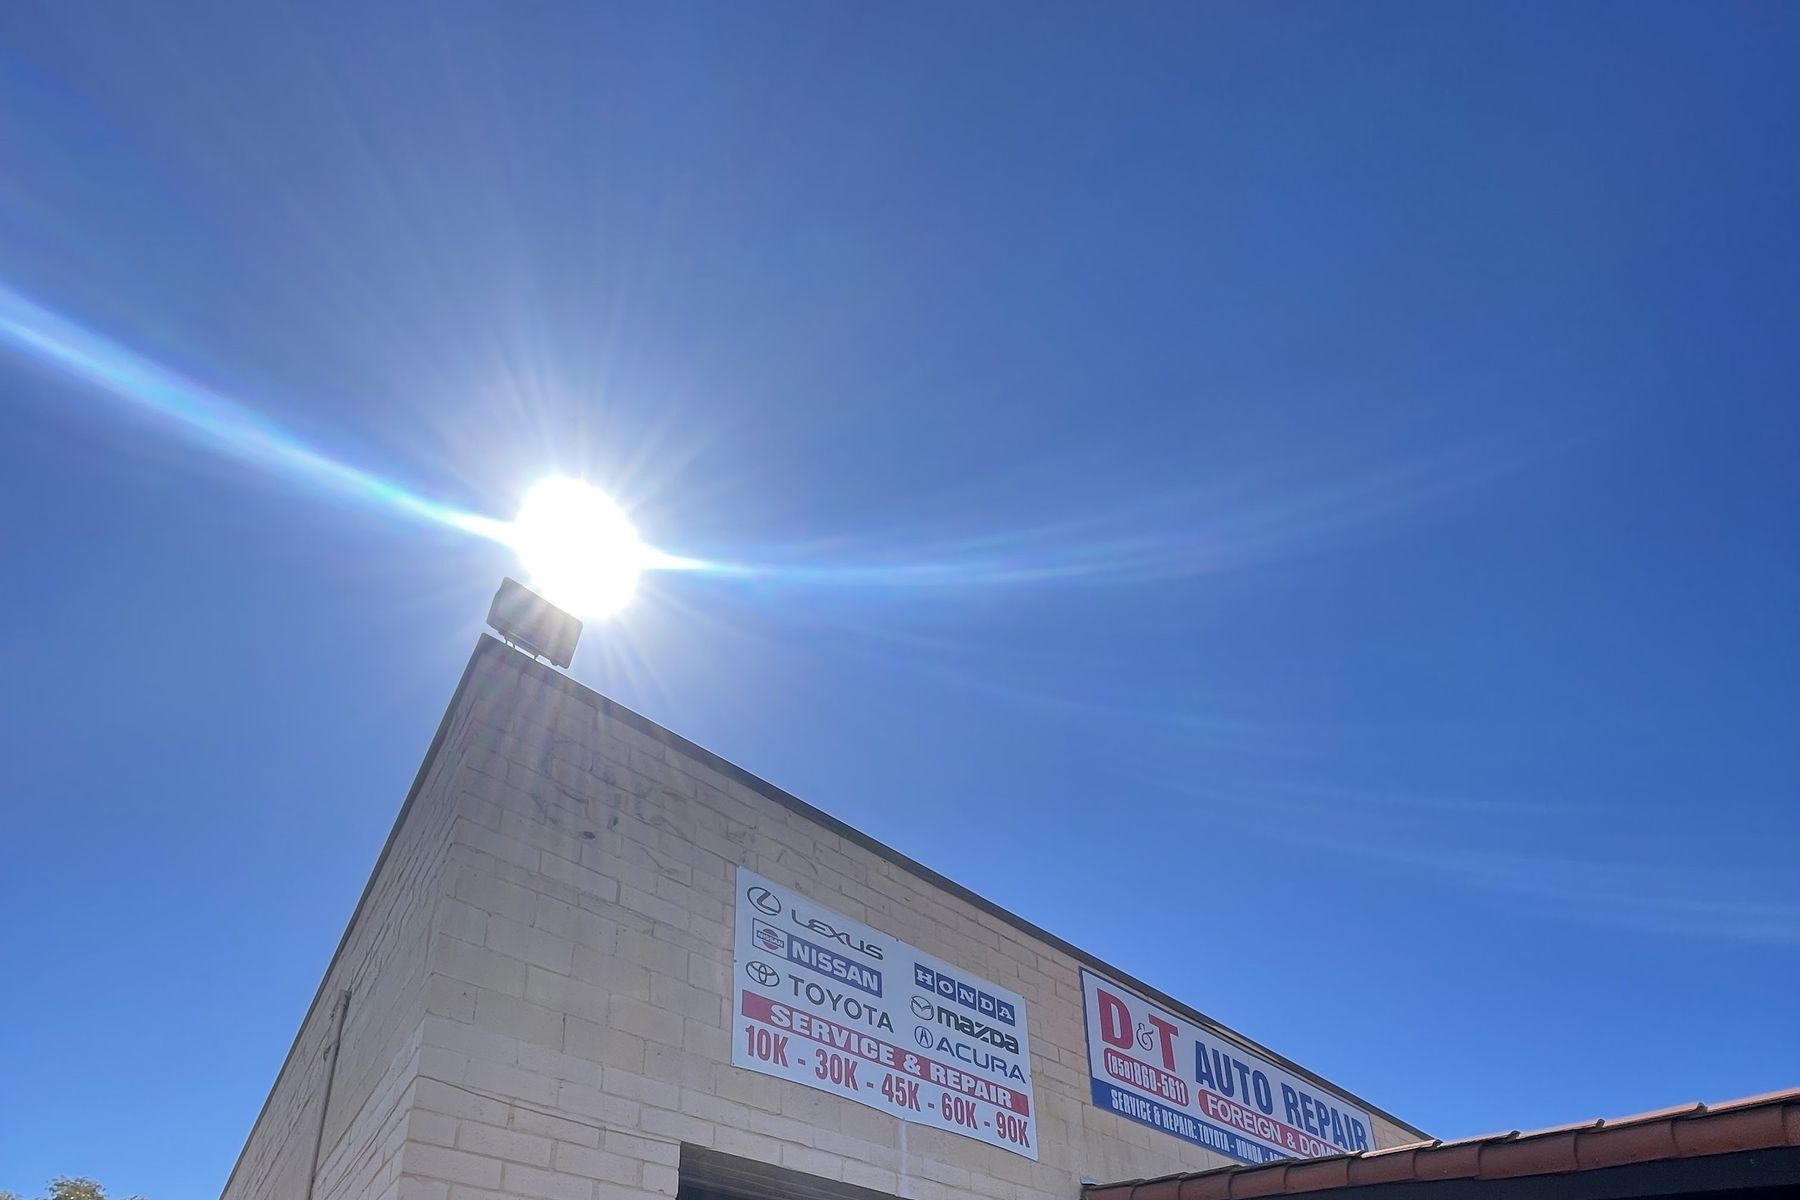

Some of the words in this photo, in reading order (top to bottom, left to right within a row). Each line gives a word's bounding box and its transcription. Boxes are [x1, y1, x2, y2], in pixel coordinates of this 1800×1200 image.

[792, 909, 883, 960] LEXUS
[793, 939, 878, 991] NISSAN
[788, 974, 894, 1033] TOYOTA
[915, 966, 1014, 1023] HONDA
[770, 1004, 895, 1065] SERVICE
[903, 1054, 921, 1076] &
[930, 1063, 1013, 1109] REPAIR
[936, 1037, 1026, 1084] ACURA
[745, 1025, 788, 1067] 10K
[815, 1048, 859, 1090] 30K
[881, 1073, 921, 1112] 45K
[942, 1102, 978, 1140] 60K
[996, 1112, 1030, 1149] 90K
[1195, 1040, 1273, 1115] AUTO
[1281, 1082, 1368, 1151] REPAIR
[1111, 1089, 1151, 1121] SERVICE
[1154, 1107, 1161, 1126] &
[1198, 1123, 1230, 1152] TOYOTA
[1236, 1138, 1263, 1163] HONDA
[1207, 1094, 1281, 1144] FOREIGN
[1287, 1132, 1296, 1149] &
